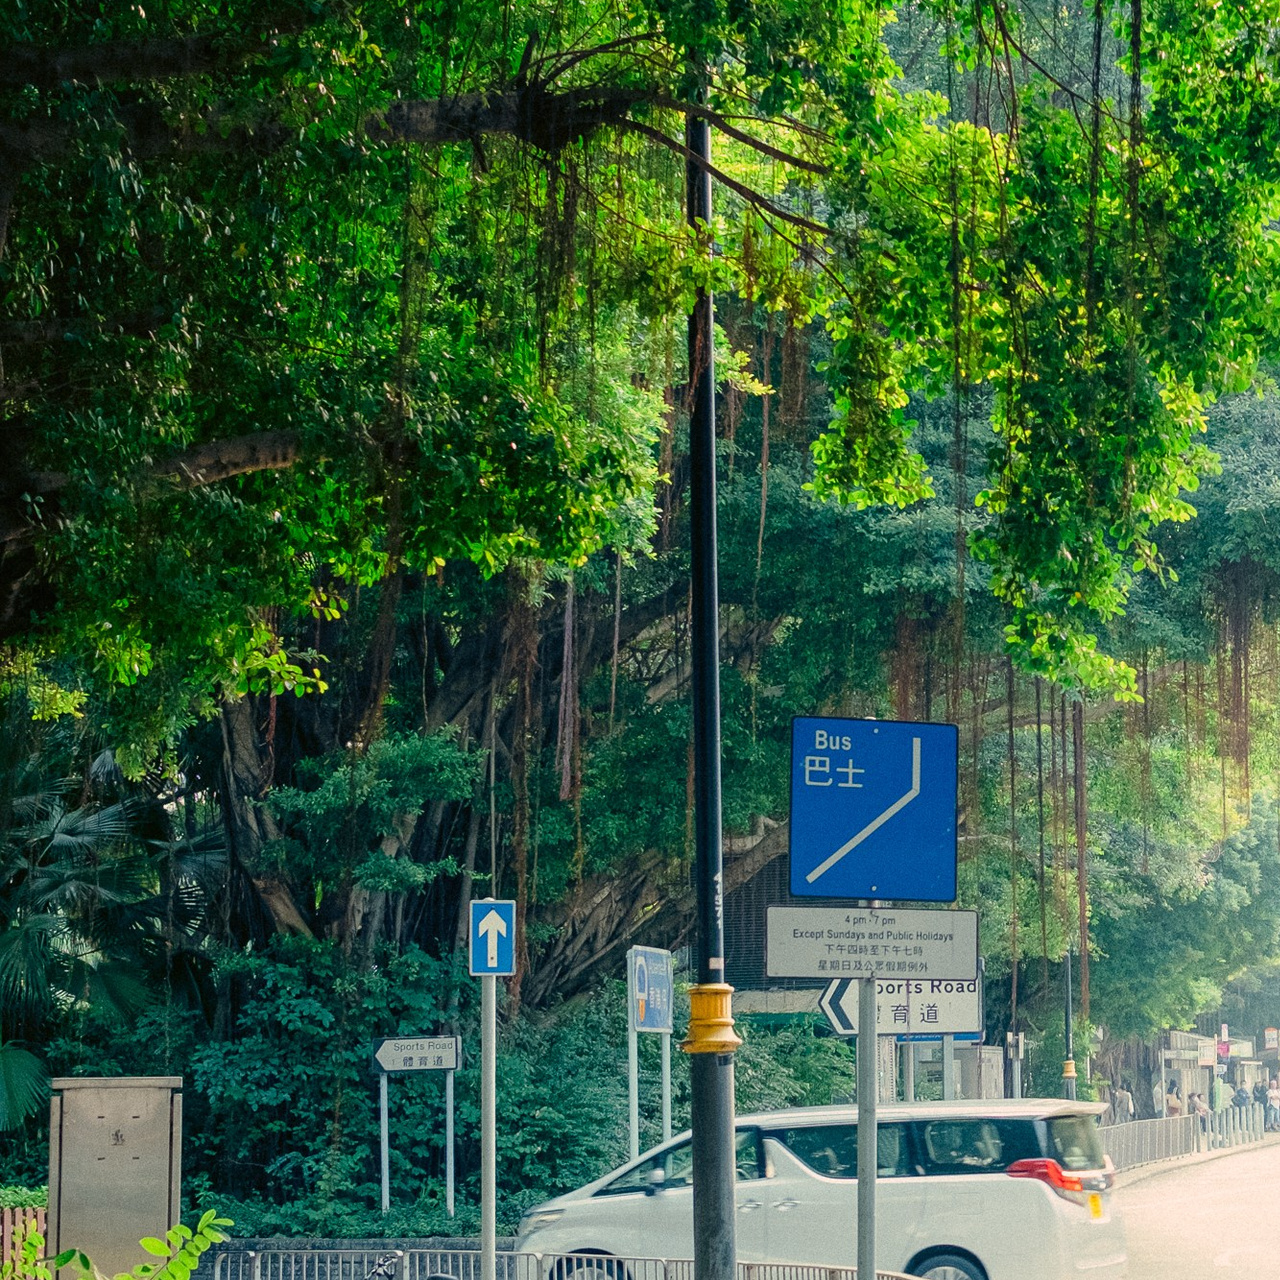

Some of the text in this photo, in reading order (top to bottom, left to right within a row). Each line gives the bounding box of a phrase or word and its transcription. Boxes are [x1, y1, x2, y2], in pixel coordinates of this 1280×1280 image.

[815, 729, 852, 751] Bus
[804, 755, 865, 788] 巴士
[844, 916, 851, 924] 4
[853, 918, 867, 926] pm
[874, 916, 880, 925] 7
[881, 918, 896, 926] pm
[793, 929, 954, 942] Except Sundays and Public Holidays
[824, 943, 924, 956] 下午四時至下午七時
[877, 980, 977, 995] ports Road
[877, 1002, 940, 1024] 育道
[393, 1040, 453, 1053] Sports Road
